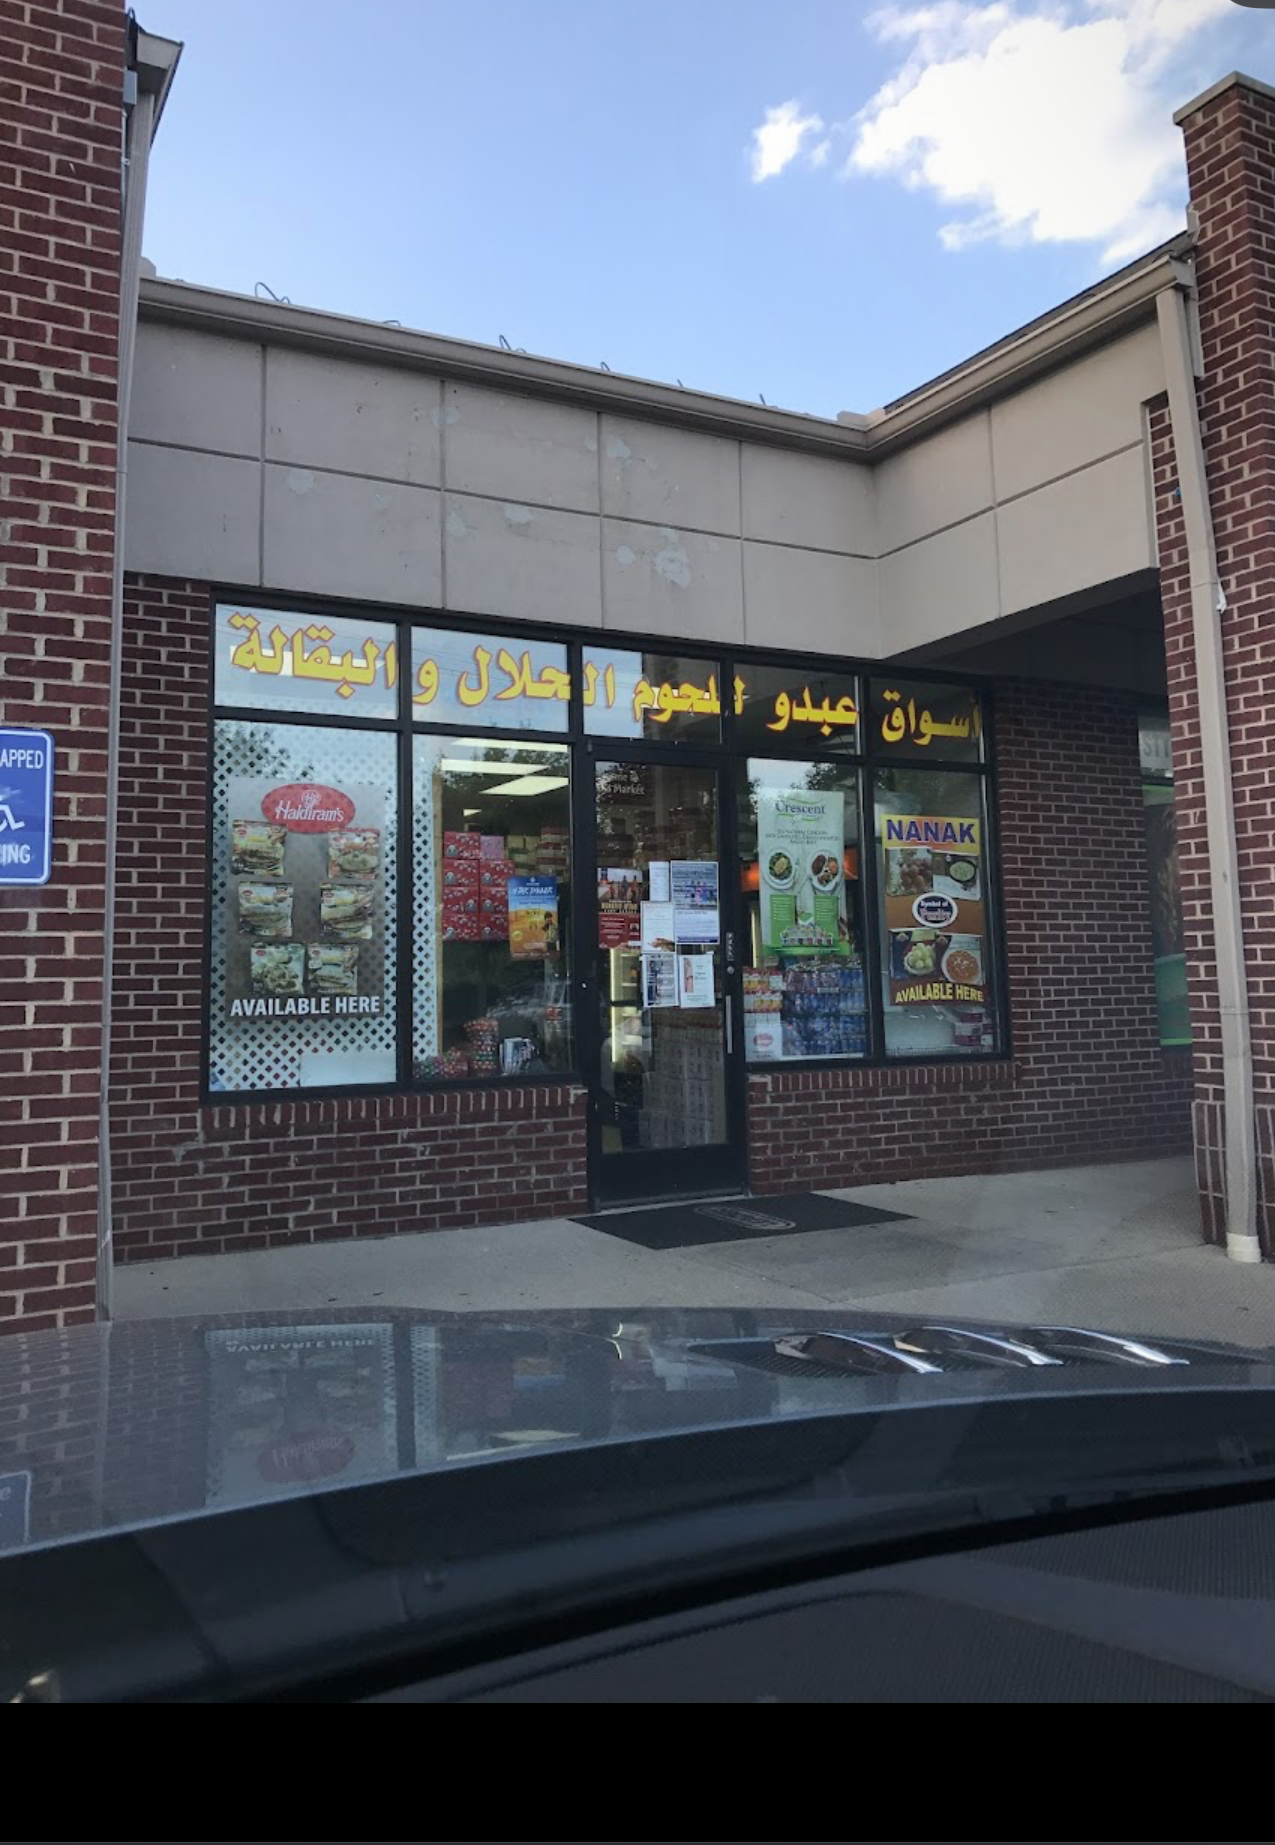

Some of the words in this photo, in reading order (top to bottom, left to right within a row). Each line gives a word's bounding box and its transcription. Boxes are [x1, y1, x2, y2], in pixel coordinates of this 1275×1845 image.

[227, 611, 398, 700] البقالة
[411, 657, 440, 706] و
[456, 644, 616, 709] الحلال
[632, 673, 746, 724] للحوم
[767, 686, 860, 737] عبدو
[275, 799, 345, 822] Haldiram's
[775, 800, 827, 814] Crescent
[886, 818, 977, 845] NANAK
[230, 997, 330, 1017] AVAILABLE
[335, 996, 381, 1014] HERE
[895, 982, 953, 1004] AVAILABLE
[955, 984, 984, 1002] HERE
